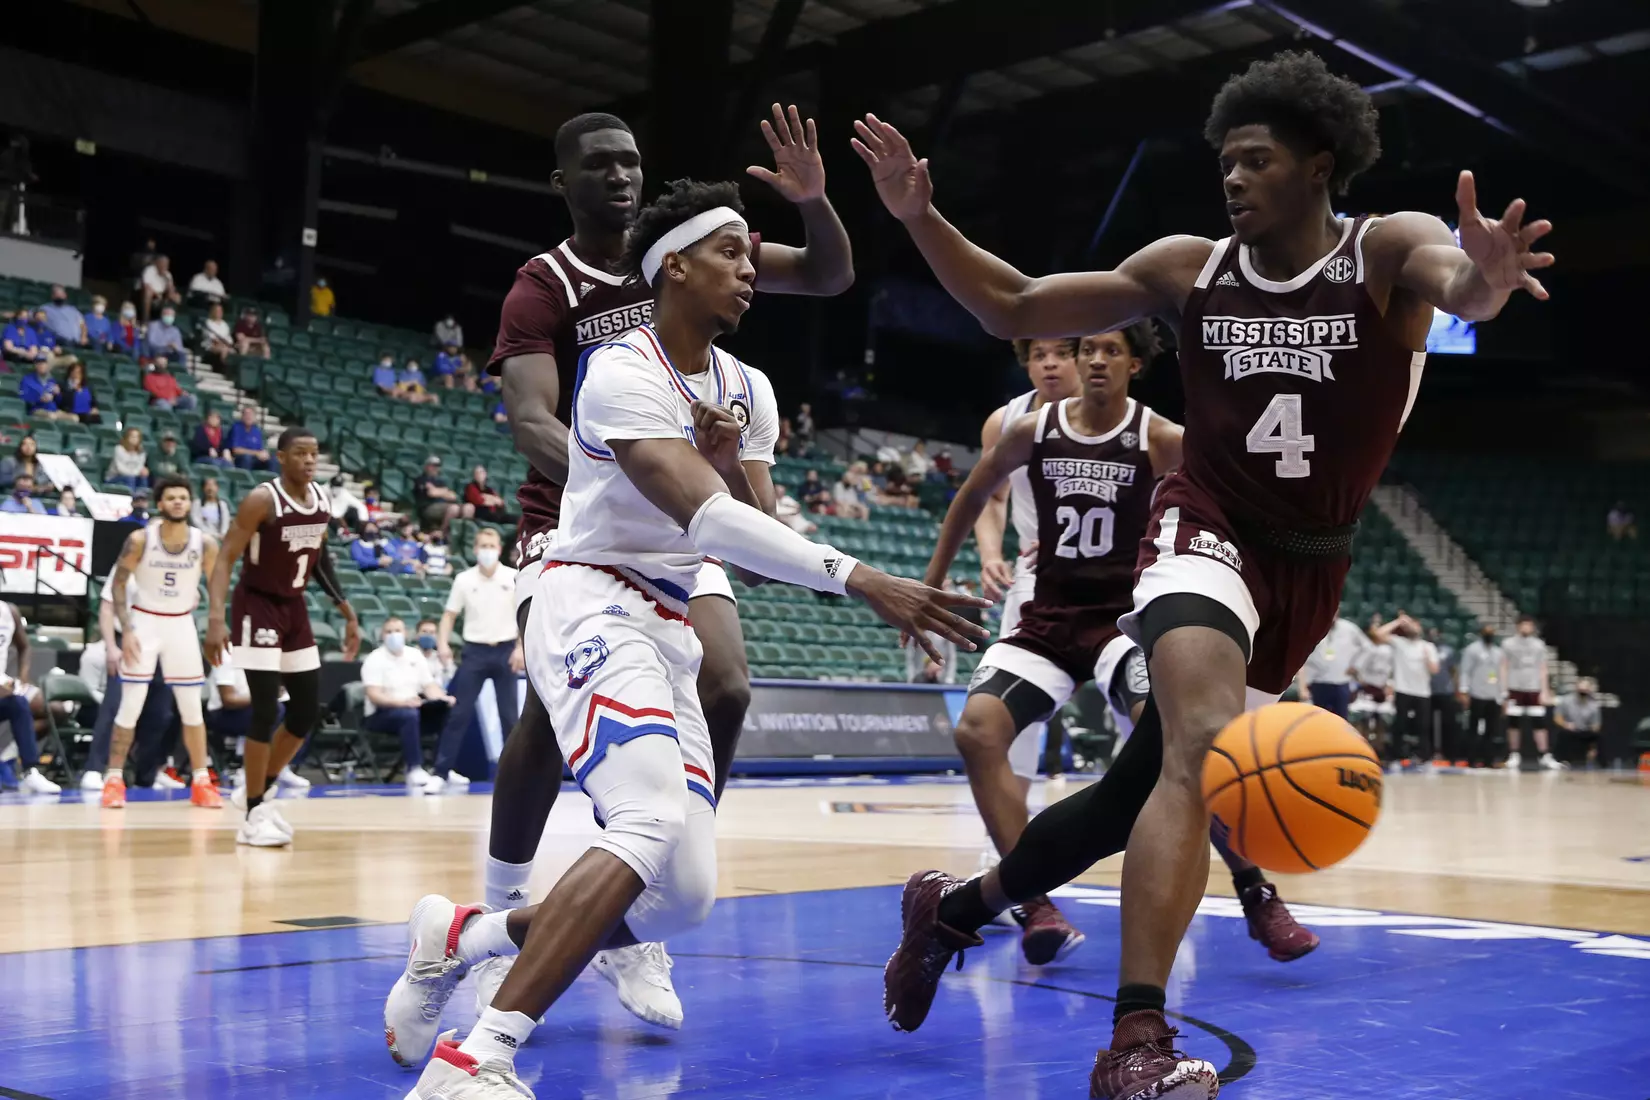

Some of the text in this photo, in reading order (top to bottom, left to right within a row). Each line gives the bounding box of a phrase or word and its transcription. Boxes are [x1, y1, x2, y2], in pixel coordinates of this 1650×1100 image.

[1325, 258, 1352, 281] SEC
[576, 304, 655, 341] MISSISS
[1202, 319, 1358, 345] MISSISSIPPI
[1239, 351, 1312, 375] STATE
[1246, 393, 1315, 479] 4
[1042, 461, 1136, 482] MISSISSIPPI
[1063, 480, 1107, 497] STATE
[1055, 506, 1116, 559] 20
[0, 535, 84, 572] SPN
[1200, 540, 1236, 563] STATE
[164, 572, 176, 587] 5
[292, 554, 309, 589] 1
[757, 712, 838, 731] INVITATION
[838, 714, 929, 732] TOURNAMENT
